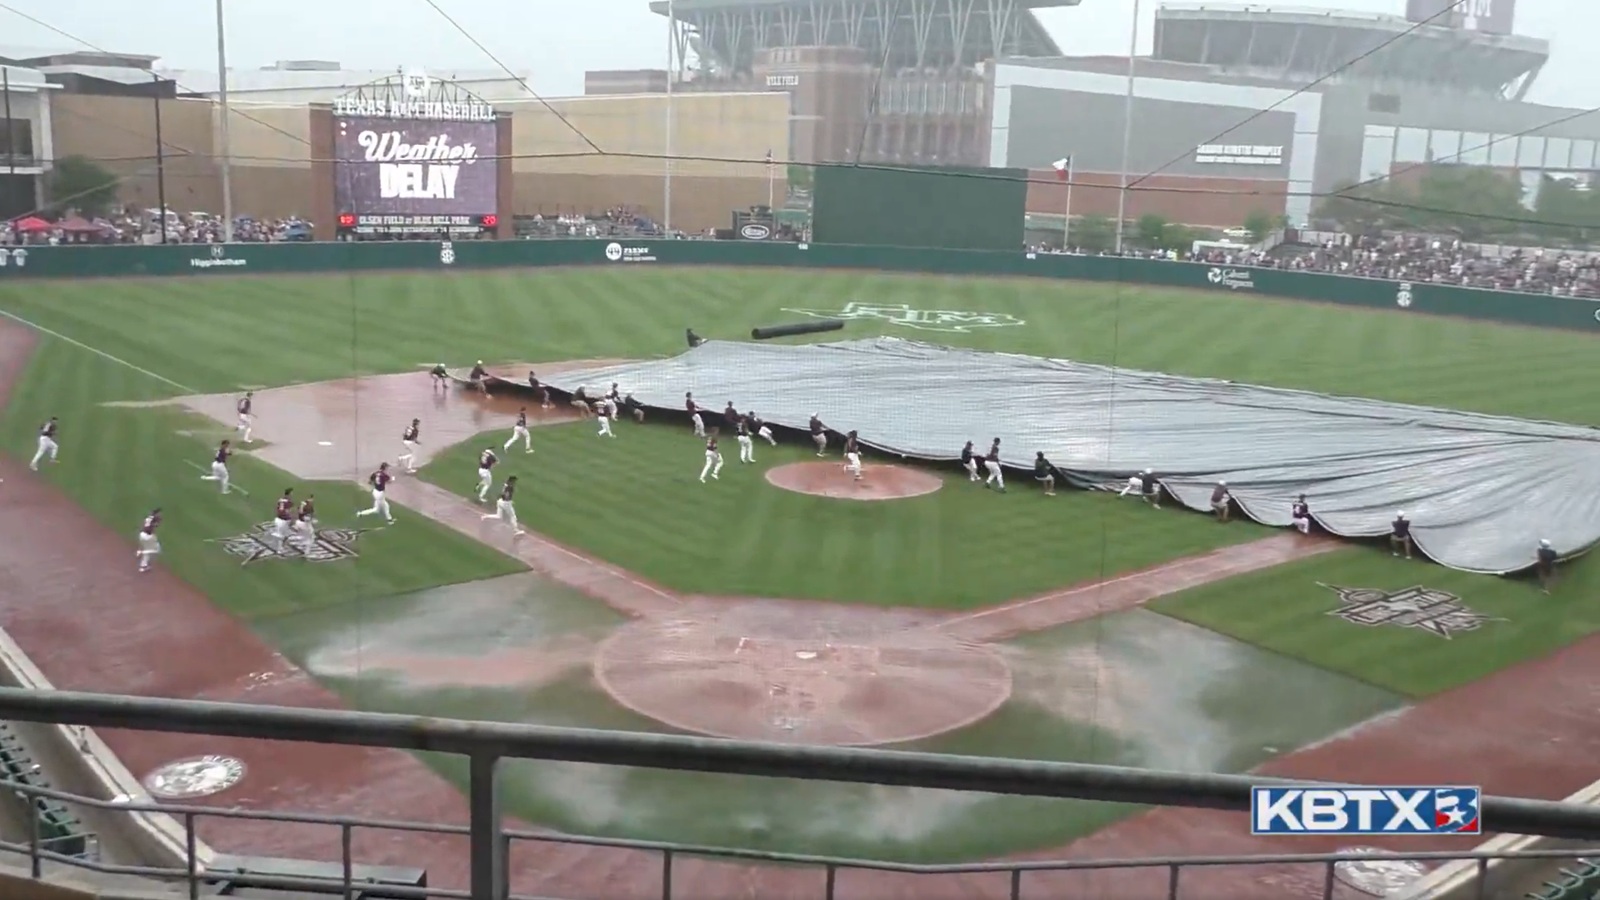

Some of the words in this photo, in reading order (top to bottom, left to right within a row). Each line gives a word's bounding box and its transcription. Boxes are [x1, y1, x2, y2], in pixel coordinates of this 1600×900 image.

[337, 100, 386, 116] TEXAS
[390, 102, 421, 118] A&M
[425, 103, 497, 121] BASEBALL
[358, 130, 477, 165] Weather
[379, 163, 460, 199] DELAY
[359, 216, 382, 225] OLSEN
[384, 216, 404, 225] FIELD
[451, 216, 470, 225] PARK
